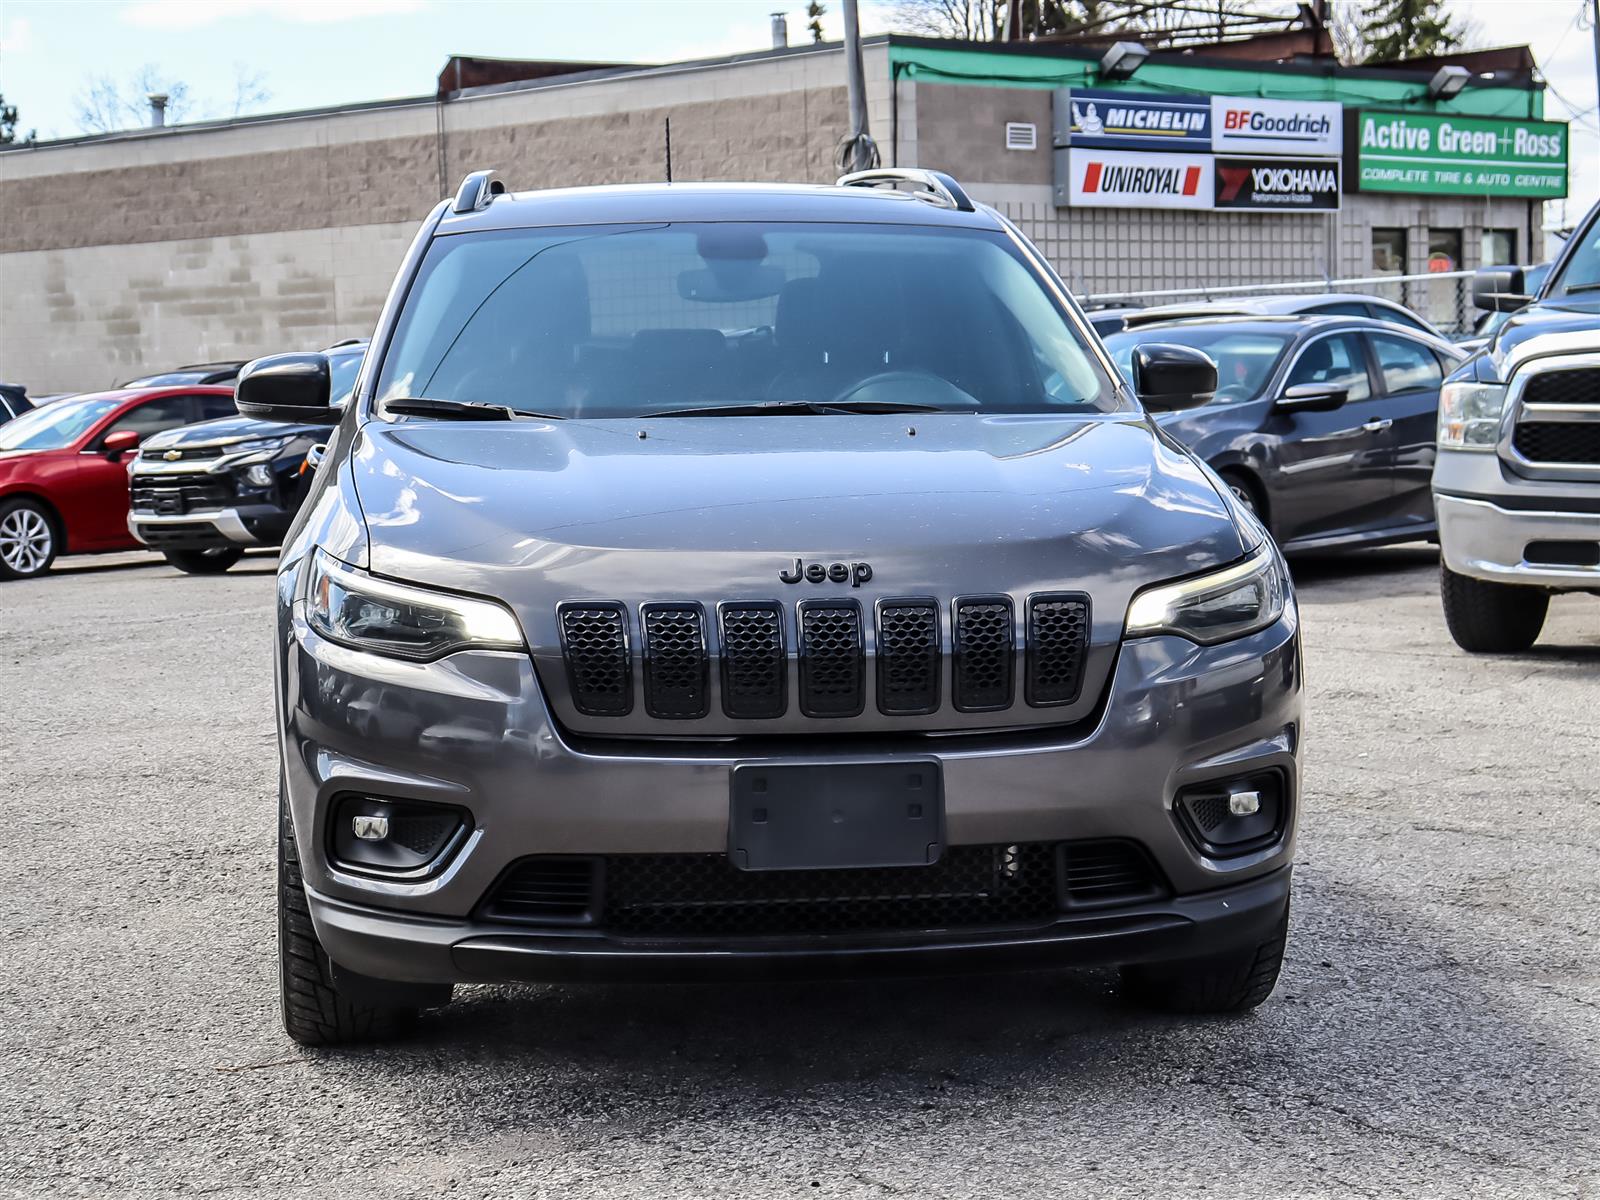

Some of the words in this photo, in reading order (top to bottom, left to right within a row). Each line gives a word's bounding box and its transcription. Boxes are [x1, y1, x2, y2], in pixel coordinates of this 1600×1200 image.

[1105, 108, 1206, 131] MICHELIN
[1224, 110, 1330, 134] BFGoodrich
[1362, 118, 1430, 151] Active
[1101, 165, 1181, 194] UNIROYAL
[1251, 167, 1338, 192] YOKOHAMA
[1362, 167, 1429, 183] COMPLETE
[1435, 171, 1461, 184] TIRE
[1463, 172, 1473, 185] &
[1476, 173, 1511, 187] AUTO
[1514, 174, 1562, 188] CENTRE
[778, 557, 873, 588] Jeep
